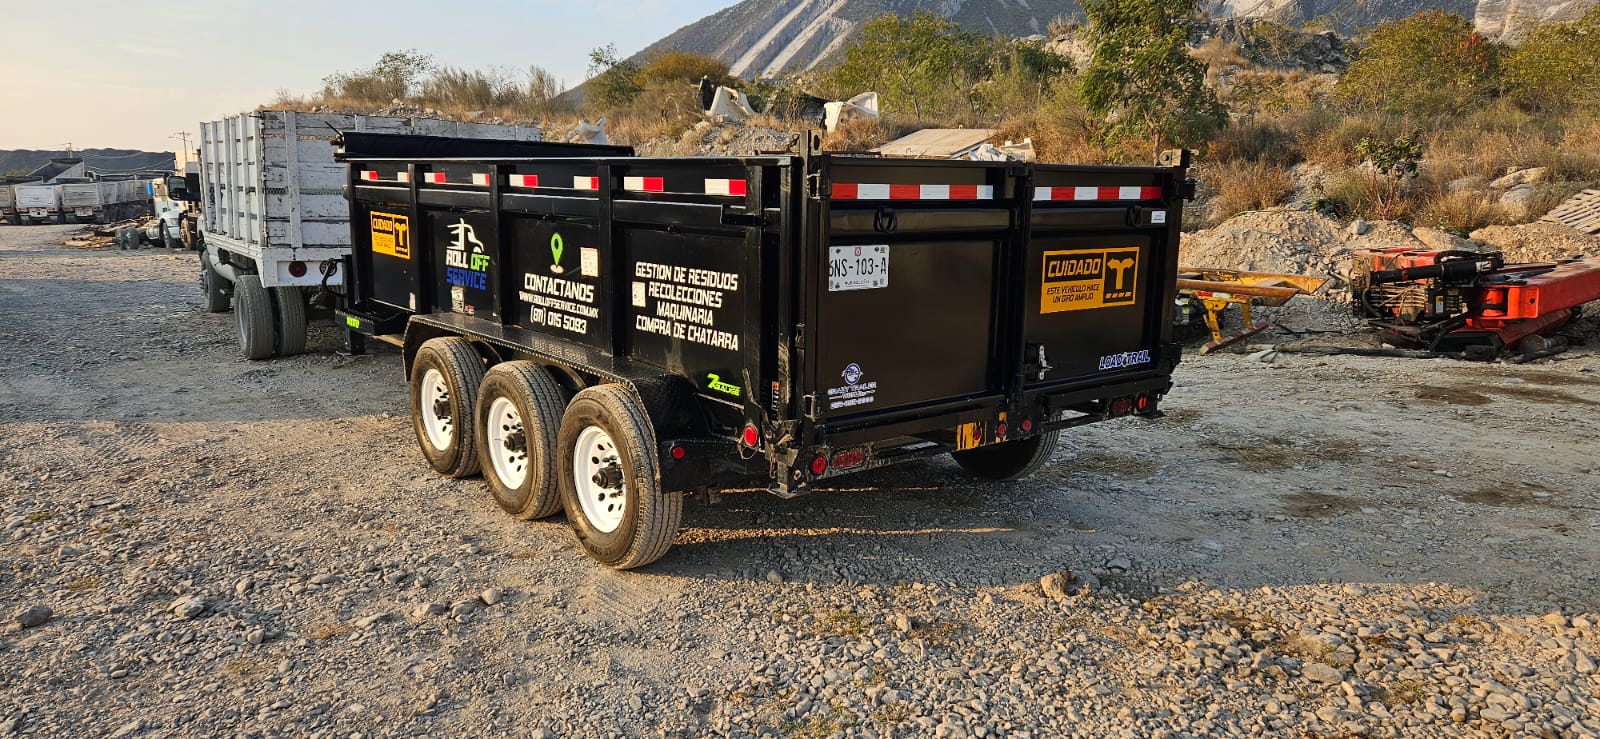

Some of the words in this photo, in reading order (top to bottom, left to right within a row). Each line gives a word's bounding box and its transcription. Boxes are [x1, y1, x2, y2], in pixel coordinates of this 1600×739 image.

[446, 249, 468, 268] ROLL
[470, 253, 490, 271] OFF
[1047, 258, 1101, 278] CUIDADO
[447, 267, 487, 290] SERVICE
[524, 272, 595, 303] CONTACTANOS
[635, 261, 672, 281] GESTION
[673, 266, 687, 283] DE
[688, 268, 738, 291] RESIDUOS
[648, 281, 723, 308] RECOLECCIONES
[1046, 286, 1061, 295] ESTE
[547, 311, 562, 328] 015
[562, 314, 587, 334] 5093
[656, 301, 713, 326] MAQUINARIA
[636, 315, 671, 336] COMPRA
[673, 322, 686, 339] DE
[687, 325, 739, 351] CHATARRA
[1099, 354, 1122, 370] LOAD
[1126, 350, 1150, 365] TRAIL
